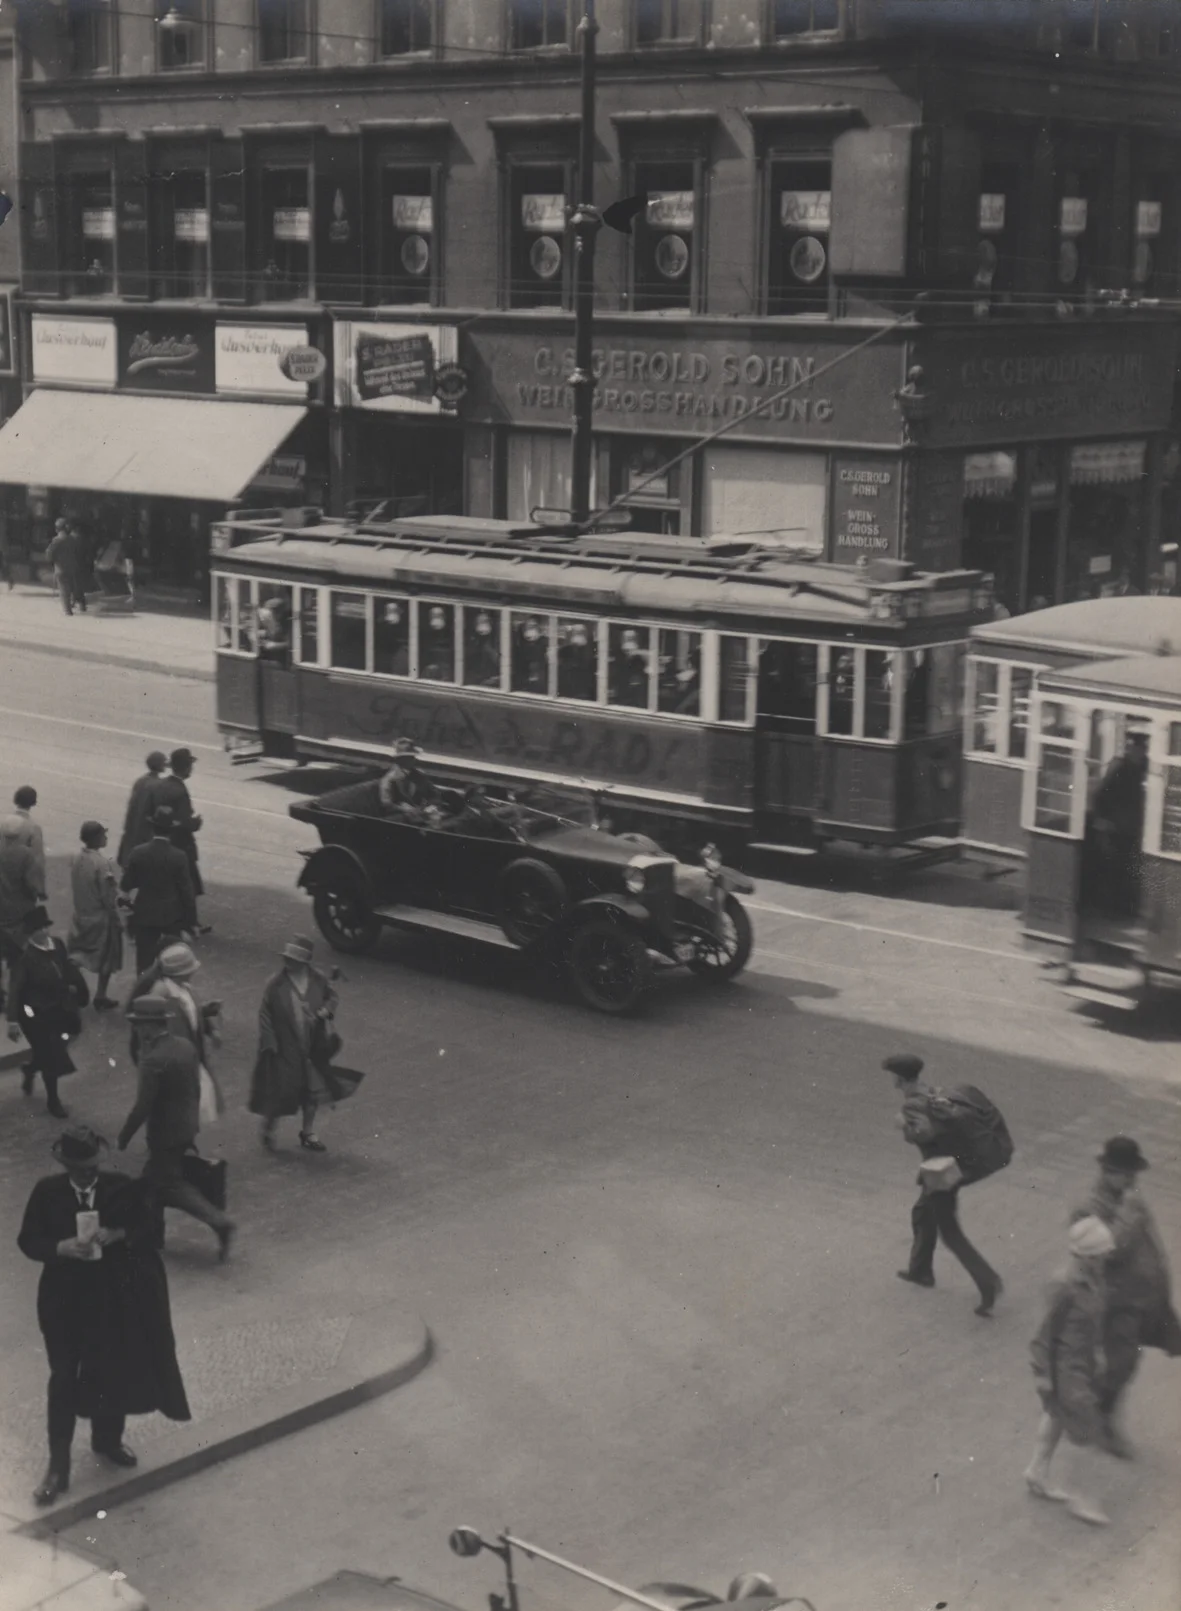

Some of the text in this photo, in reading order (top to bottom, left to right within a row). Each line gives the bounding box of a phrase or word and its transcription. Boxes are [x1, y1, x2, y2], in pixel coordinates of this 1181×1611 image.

[722, 353, 815, 389] SOHN
[852, 484, 878, 497] SOHN
[847, 523, 880, 535] GROSS
[838, 534, 889, 550] HANDLUNG
